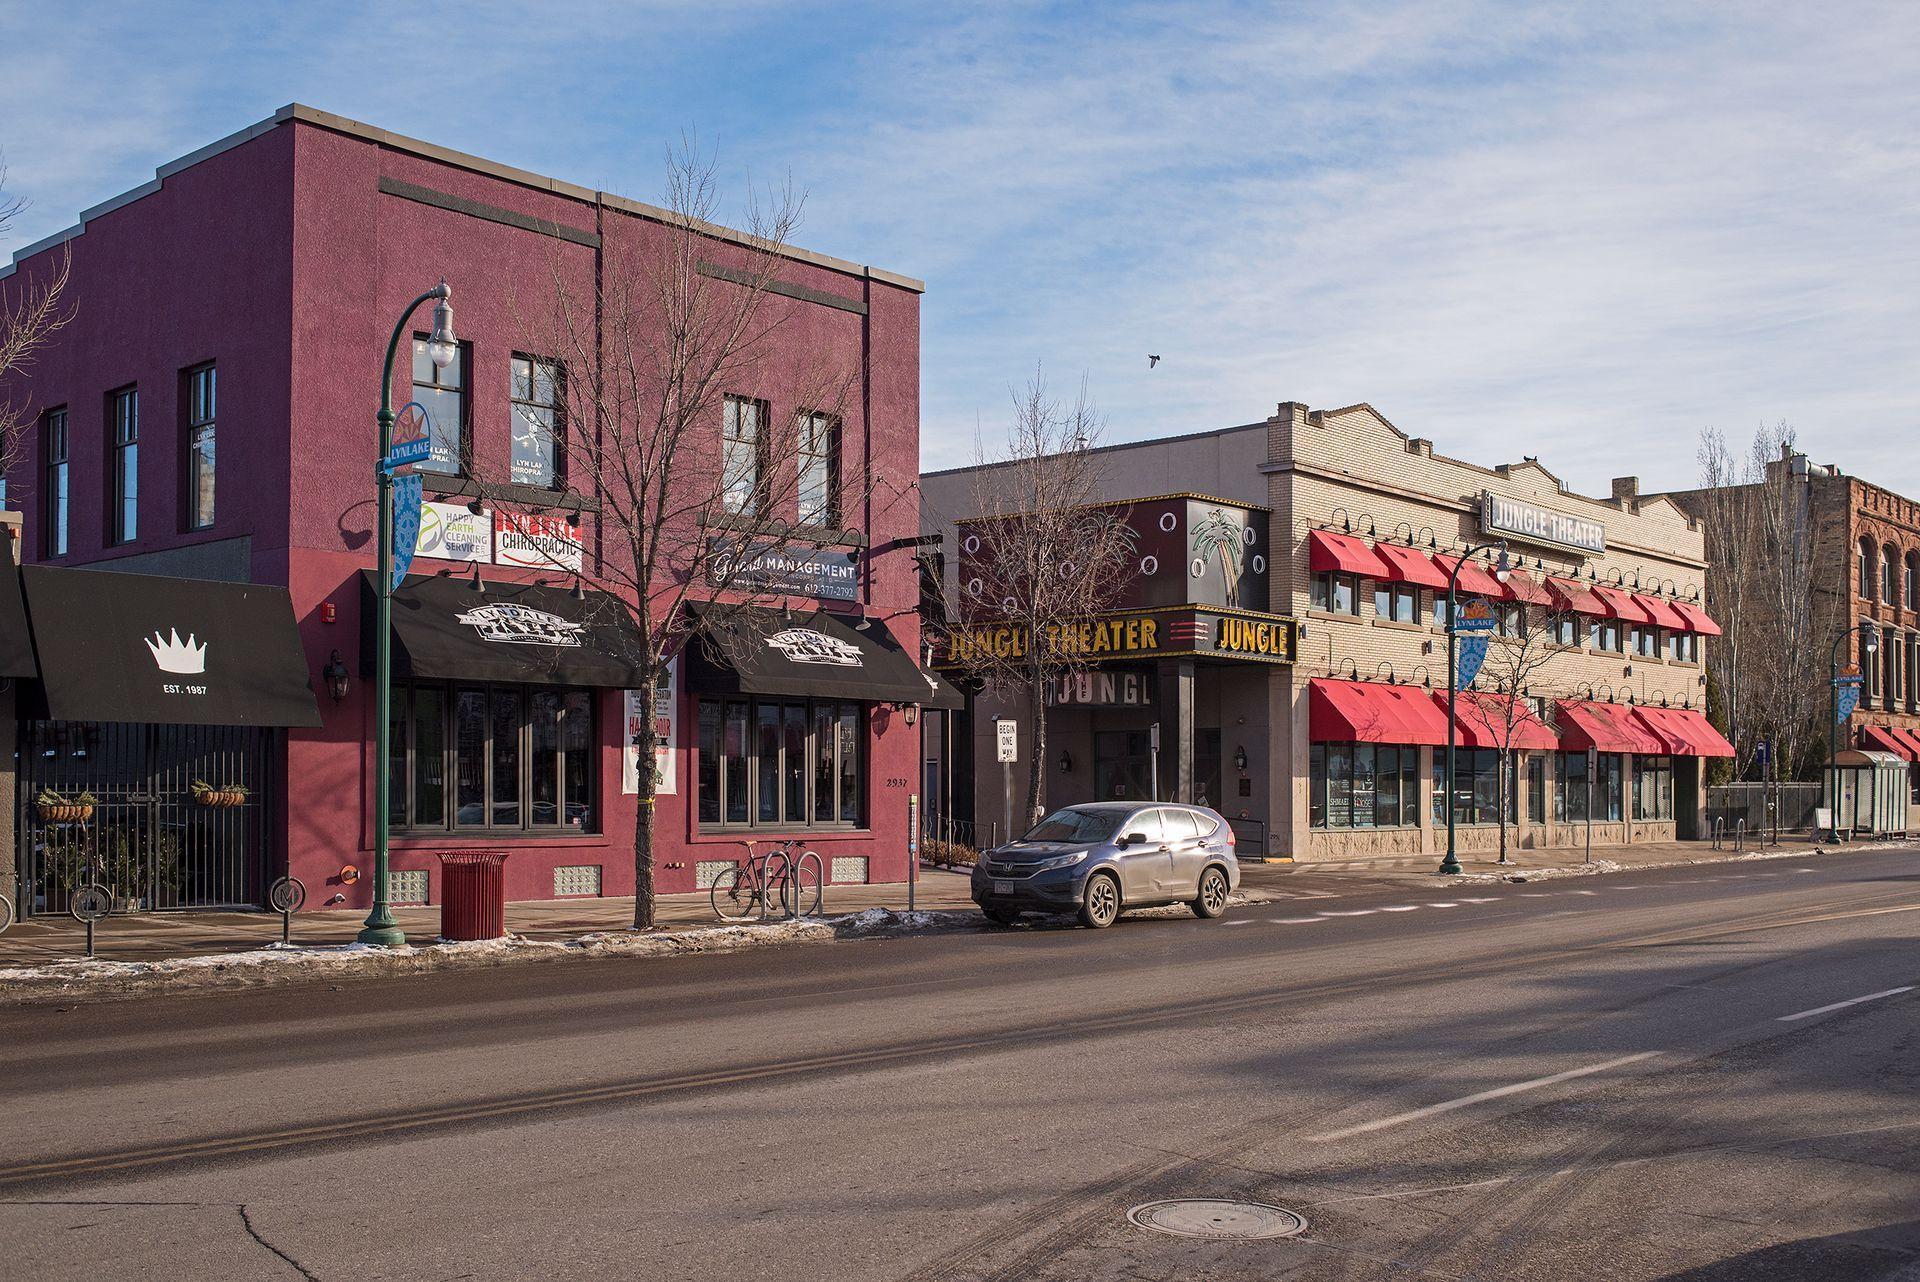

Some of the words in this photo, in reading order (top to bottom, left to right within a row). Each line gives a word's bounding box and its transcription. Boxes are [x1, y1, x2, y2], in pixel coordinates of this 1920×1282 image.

[391, 441, 430, 460] LYNLAKE
[446, 512, 475, 524] HAPPY
[502, 513, 531, 535] LYN
[1496, 501, 1548, 537] JUNGLE
[1550, 512, 1604, 550] THEATER
[446, 522, 475, 534] EARTH
[445, 532, 488, 545] CLEANING
[502, 532, 578, 556] CHIROPRACTIC
[766, 557, 855, 579] MANAGEMENT
[804, 583, 854, 598] 612-377-2792
[1457, 619, 1494, 627] LYNLAKE
[947, 627, 1029, 661] JUNGL
[1046, 618, 1158, 654] THEATER
[1220, 618, 1288, 656] JUNGLE
[163, 684, 184, 694] EST.
[186, 685, 207, 695] 1987
[998, 724, 1016, 734] BEGIN
[1001, 736, 1013, 746] ONE
